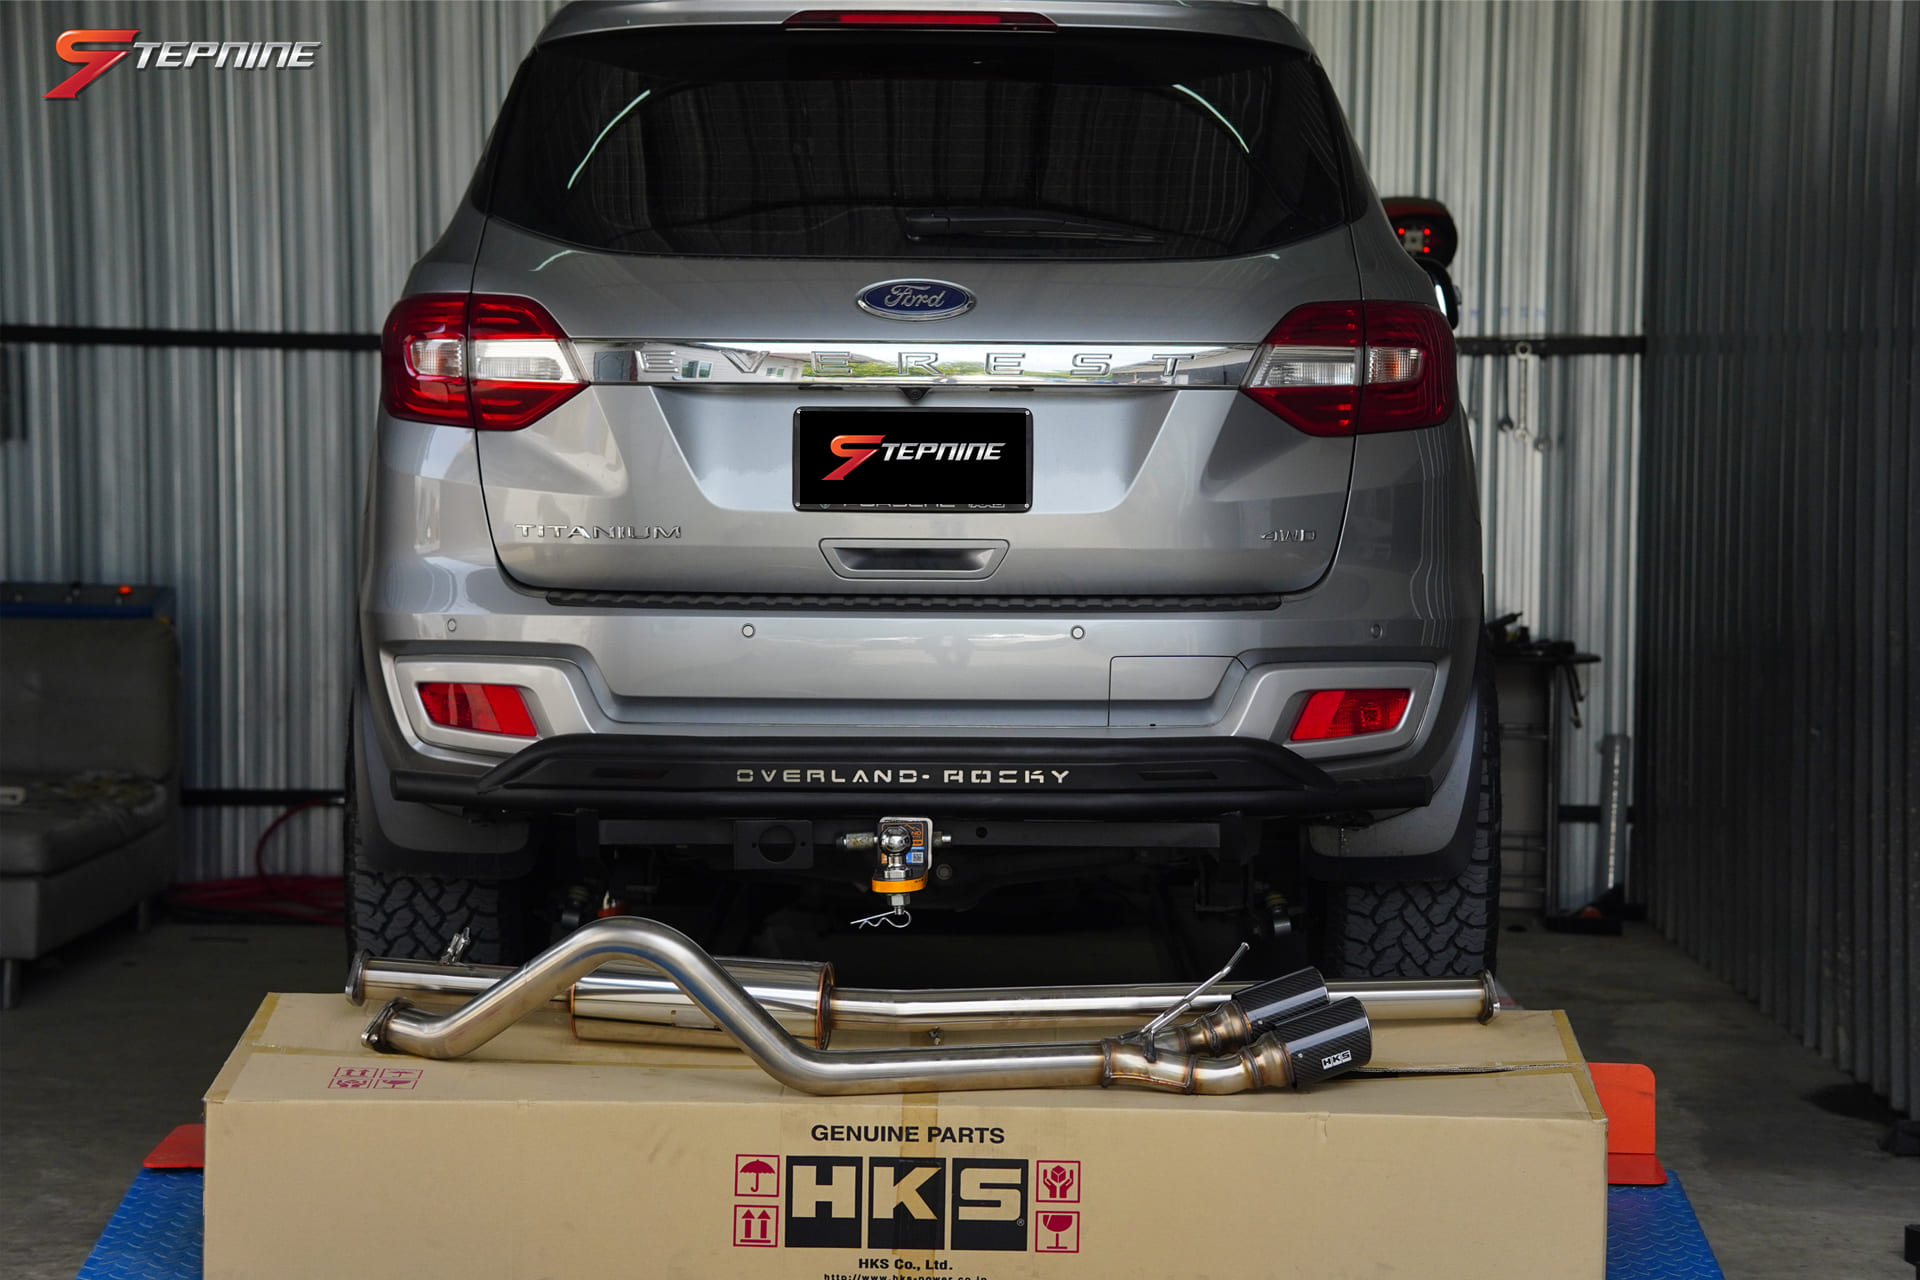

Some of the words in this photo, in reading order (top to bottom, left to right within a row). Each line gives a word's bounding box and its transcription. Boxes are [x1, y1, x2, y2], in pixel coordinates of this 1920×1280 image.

[884, 284, 946, 308] Ford
[636, 349, 1198, 378] EVEREST
[515, 523, 682, 540] TITANIUM
[1260, 529, 1317, 542] 4WD
[943, 769, 1070, 784] ROCKY
[1322, 1051, 1351, 1069] HKS
[811, 1124, 919, 1143] GENUINE
[927, 1126, 1005, 1144] PARTS
[789, 1161, 1024, 1224] HKS
[858, 1258, 889, 1270] HKS
[894, 1259, 921, 1272] Co.,
[925, 1259, 953, 1271] Ltd.
